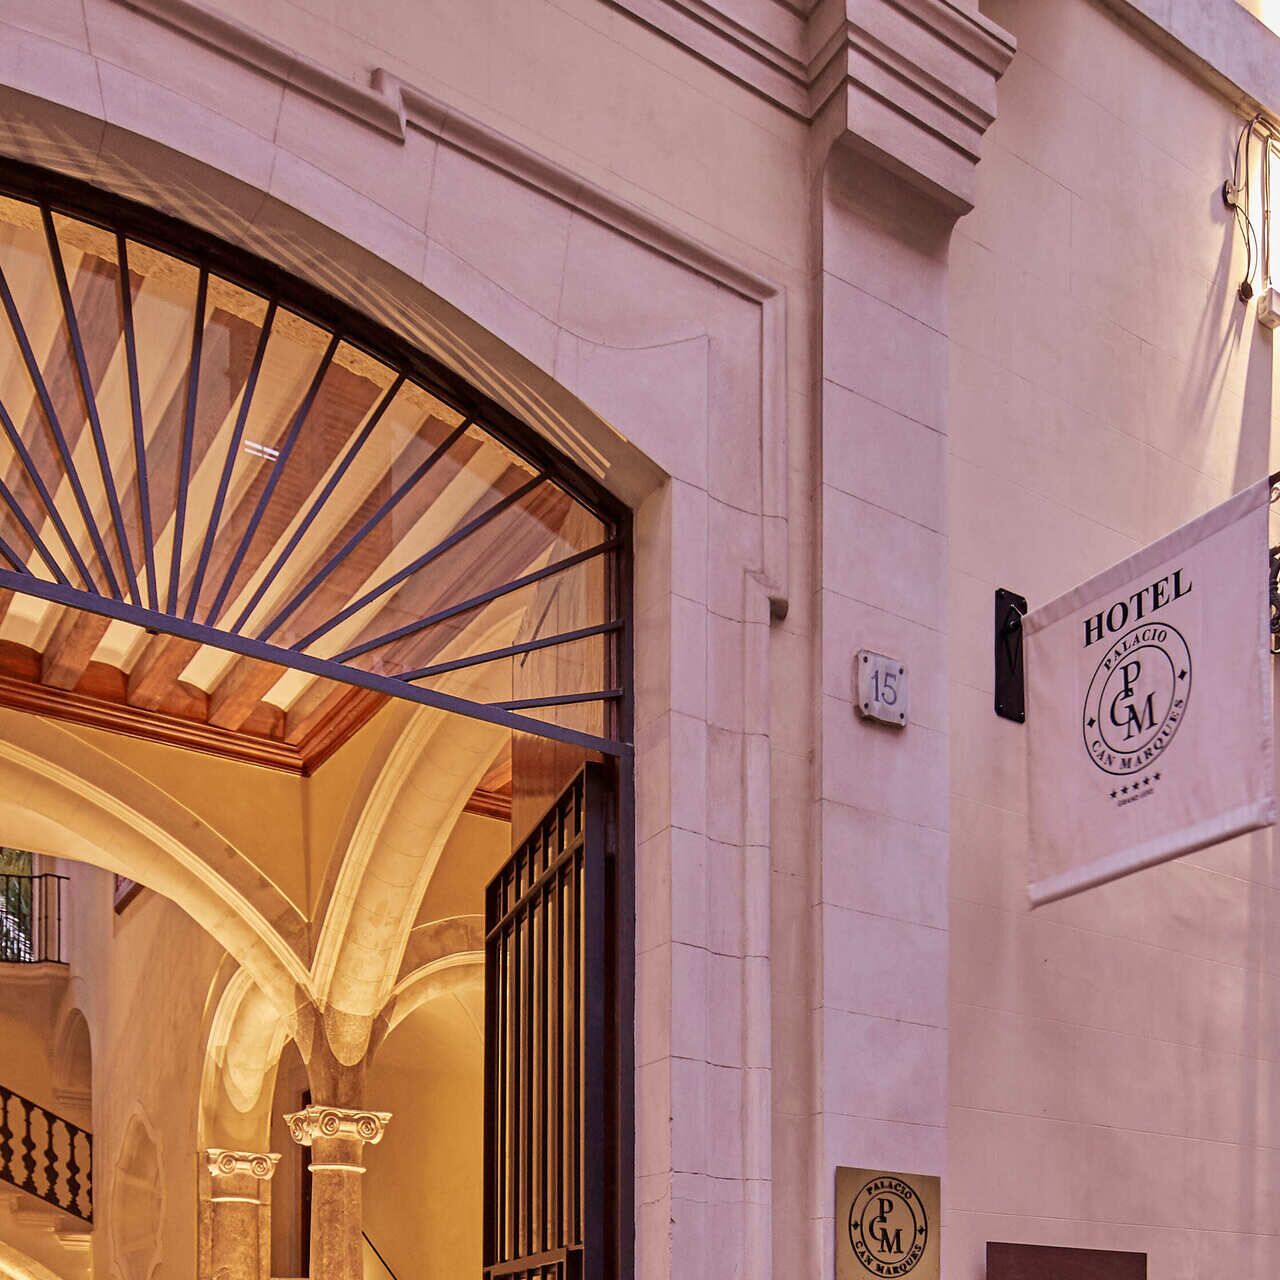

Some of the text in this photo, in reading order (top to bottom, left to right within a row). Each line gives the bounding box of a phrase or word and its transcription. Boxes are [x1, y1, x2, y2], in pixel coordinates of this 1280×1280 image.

[1083, 567, 1193, 648] HOTEL
[1103, 628, 1168, 671] PALACIO
[870, 669, 897, 706] 15
[1092, 699, 1184, 770] CAN MARQUES
[865, 1181, 913, 1200] PALACIO
[855, 1240, 922, 1275] CAN MARQUES
